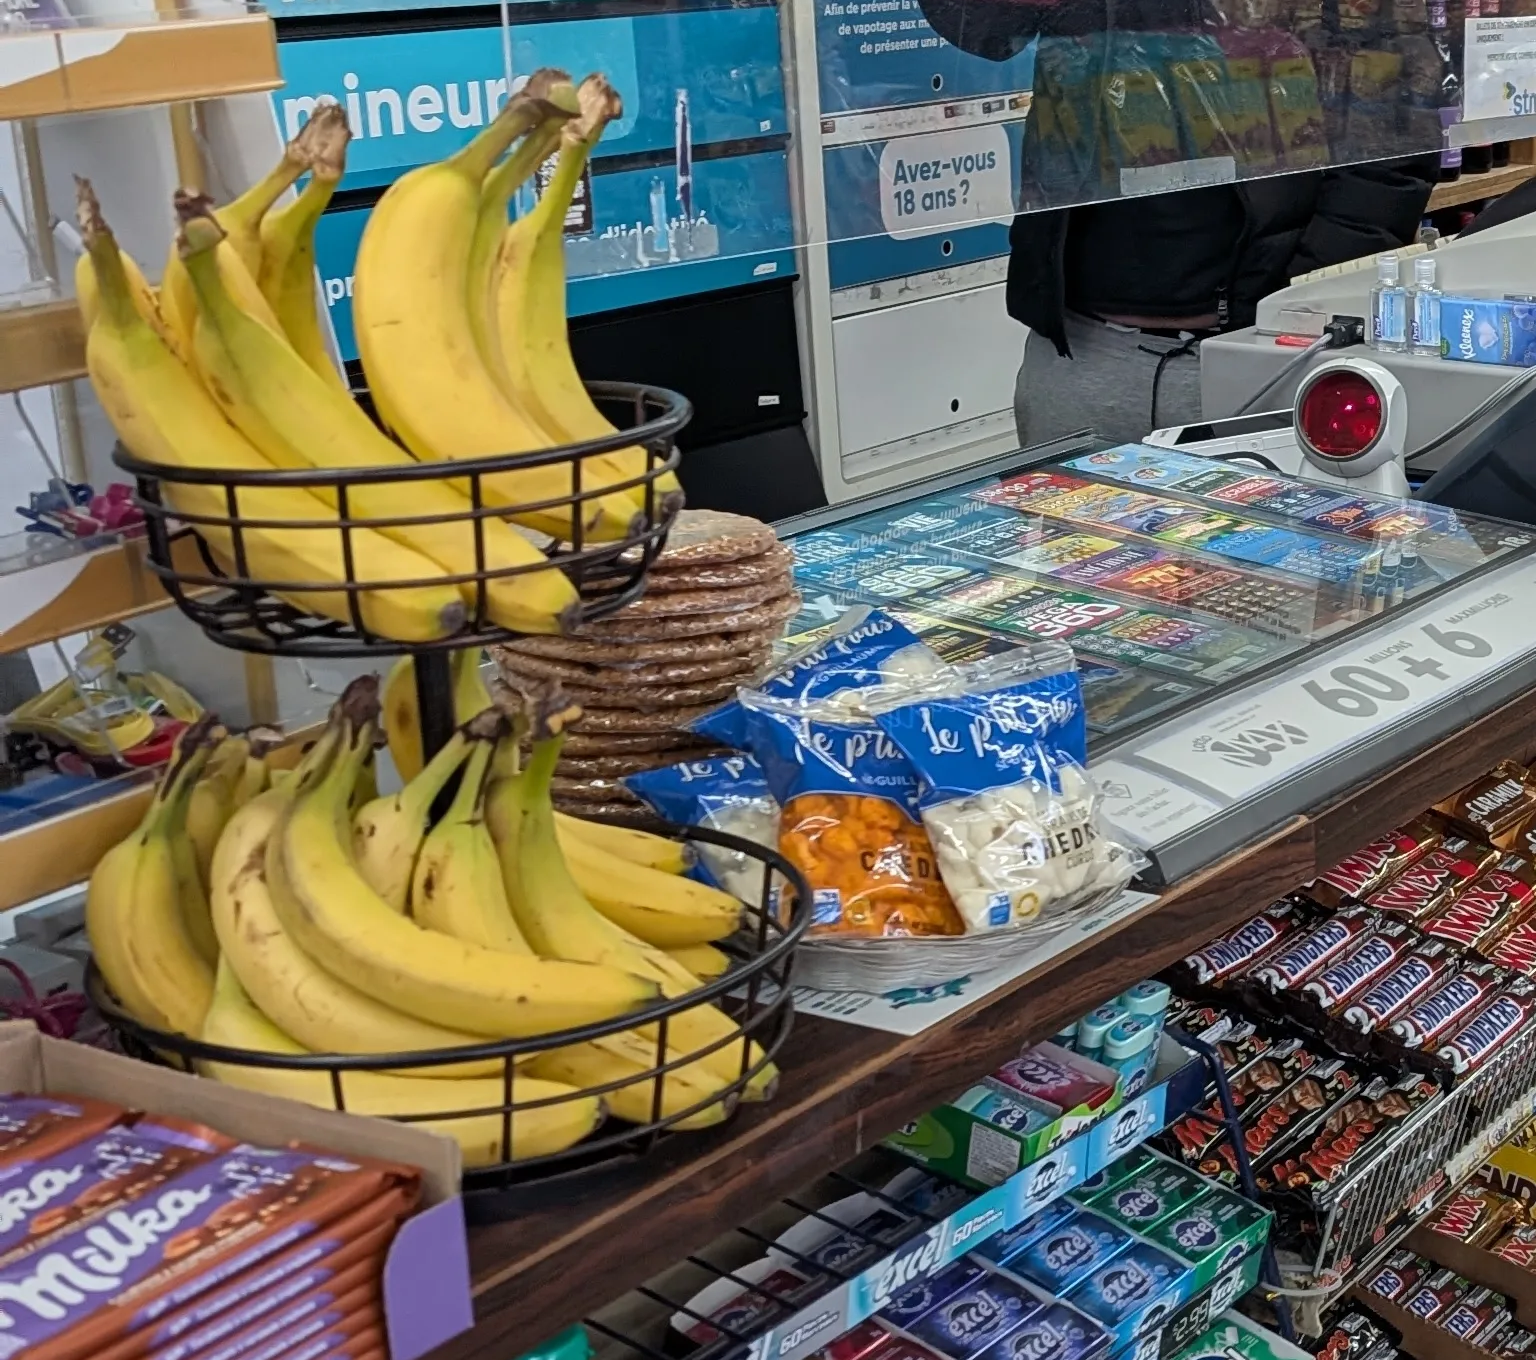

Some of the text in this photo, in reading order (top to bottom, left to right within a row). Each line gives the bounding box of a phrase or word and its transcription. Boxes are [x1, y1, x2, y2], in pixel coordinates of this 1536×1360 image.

[824, 3, 844, 16] Afin
[846, 2, 859, 14] de
[902, 0, 911, 10] la
[838, 20, 916, 35] de vapotage aux
[860, 38, 938, 54] de présenter une
[893, 150, 997, 186] Avez-vous
[894, 188, 915, 217] 18
[1013, 601, 1085, 628] MEGA
[1028, 603, 1122, 639] 360
[1300, 664, 1411, 718] 60
[1419, 623, 1494, 659] 6
[1368, 640, 1413, 667] MILLIONS
[1465, 779, 1524, 816] CARAMILK
[1210, 916, 1275, 971] SNICKERS
[1285, 919, 1349, 978] SNICKERS
[1324, 938, 1394, 996] SNICKERS
[1101, 1258, 1149, 1305] excel
